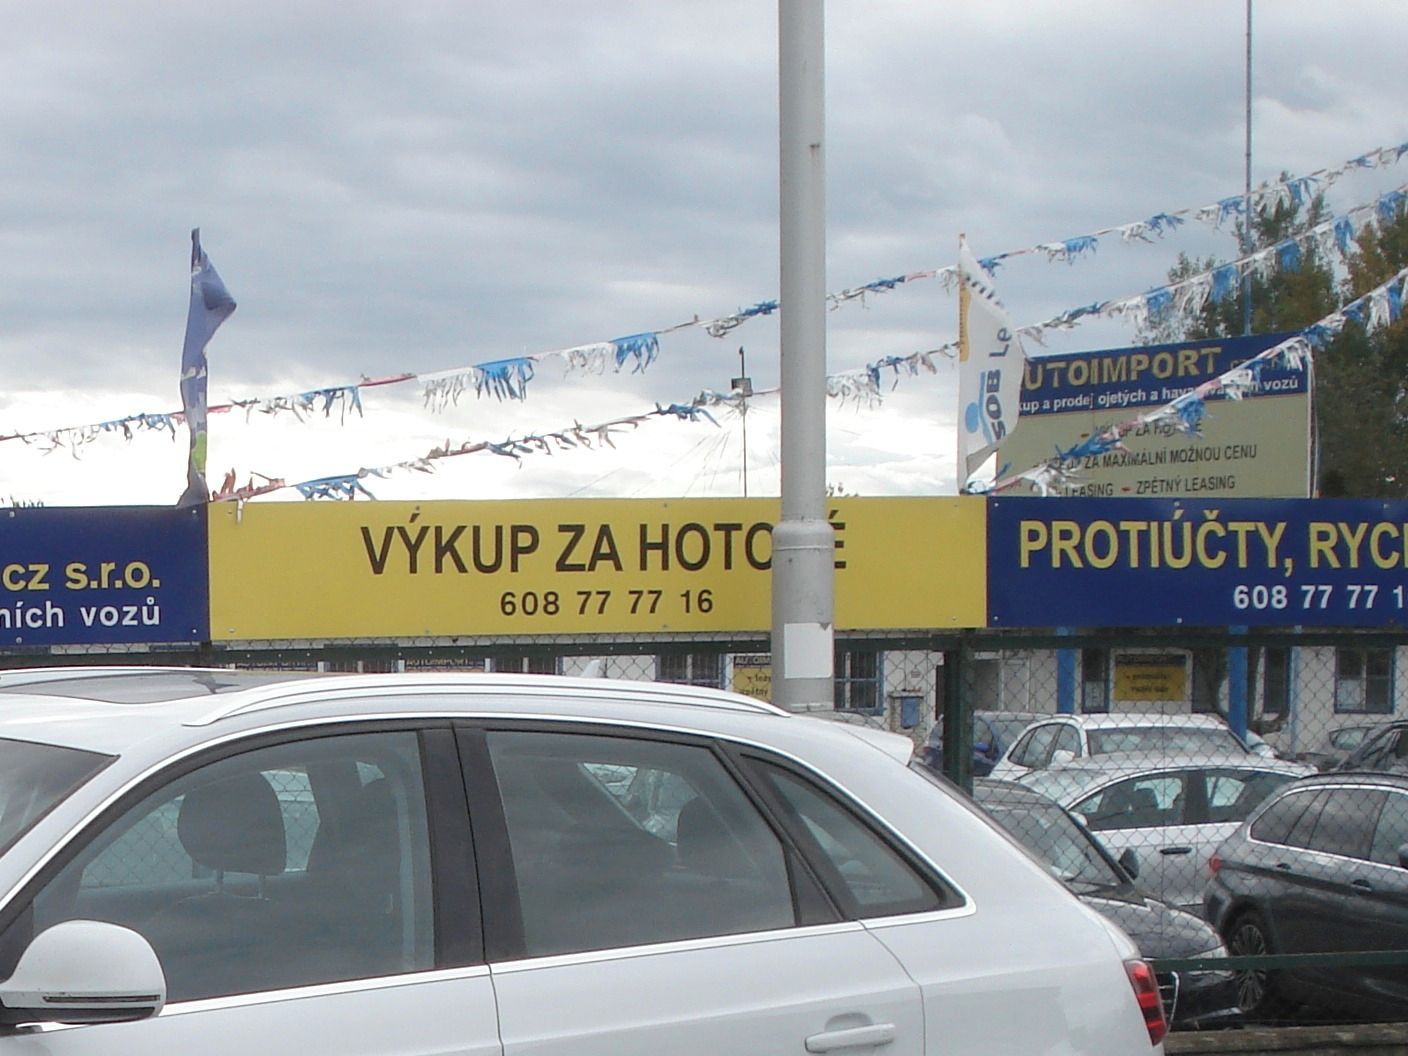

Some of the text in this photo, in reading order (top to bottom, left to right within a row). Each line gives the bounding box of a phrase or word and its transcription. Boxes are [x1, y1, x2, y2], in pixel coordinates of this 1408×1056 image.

[1023, 346, 1222, 391] UTOIMPORT
[985, 368, 1006, 442] SOB
[1042, 399, 1050, 409] a
[1053, 393, 1095, 412] prodej
[1098, 388, 1146, 408] ojetých
[1150, 390, 1159, 401] a
[1170, 445, 1222, 463] MOŽNOU
[1224, 445, 1258, 460] CENU
[1184, 475, 1236, 492] LEASING
[360, 509, 848, 576] VÝKUP ZA HOTOÉ
[1019, 508, 1408, 578] PROTIÚČTY, RYC
[65, 560, 161, 590] s.r.o.
[80, 596, 161, 626] vozů
[499, 589, 714, 616] 608 77 77 16
[1233, 584, 1288, 610] 608
[1300, 585, 1333, 609] 77
[1346, 585, 1379, 609] 77
